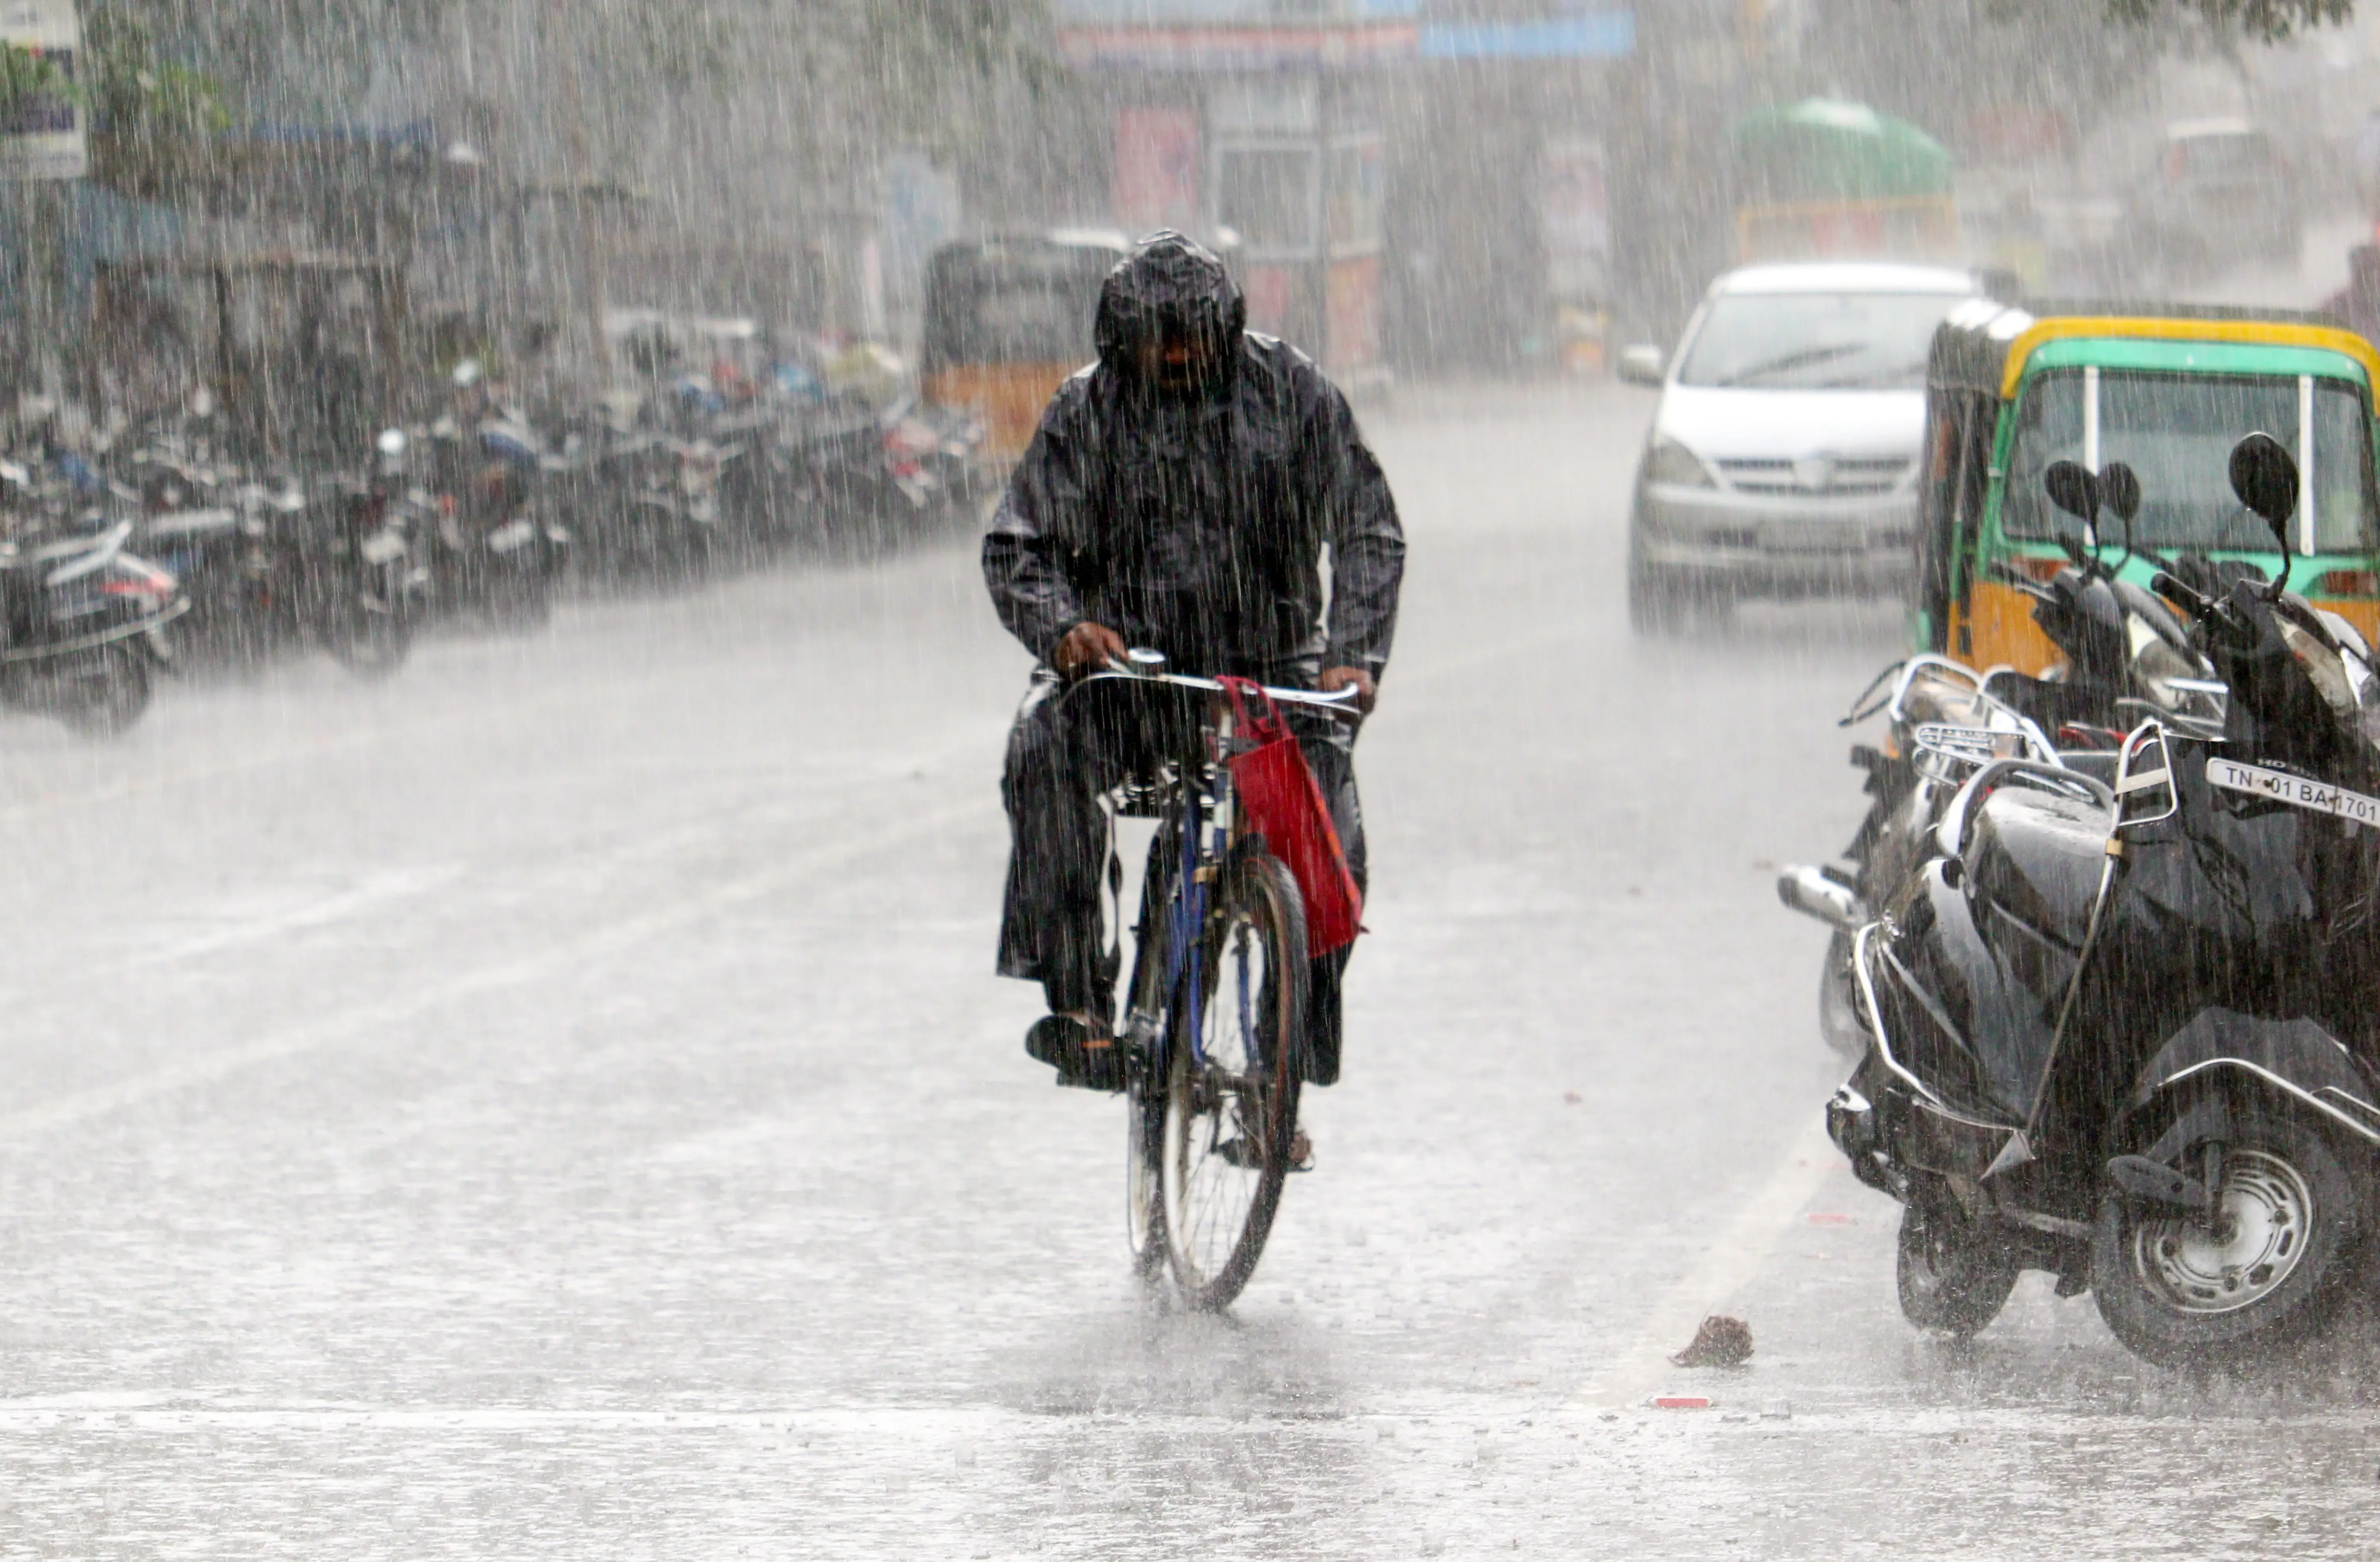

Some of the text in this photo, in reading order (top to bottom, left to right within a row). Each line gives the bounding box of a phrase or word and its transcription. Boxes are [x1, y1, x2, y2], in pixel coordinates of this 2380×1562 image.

[2226, 767, 2252, 787] TN
[2271, 777, 2290, 796] 01
[2300, 785, 2327, 806] BA
[2336, 795, 2376, 821] 1701
